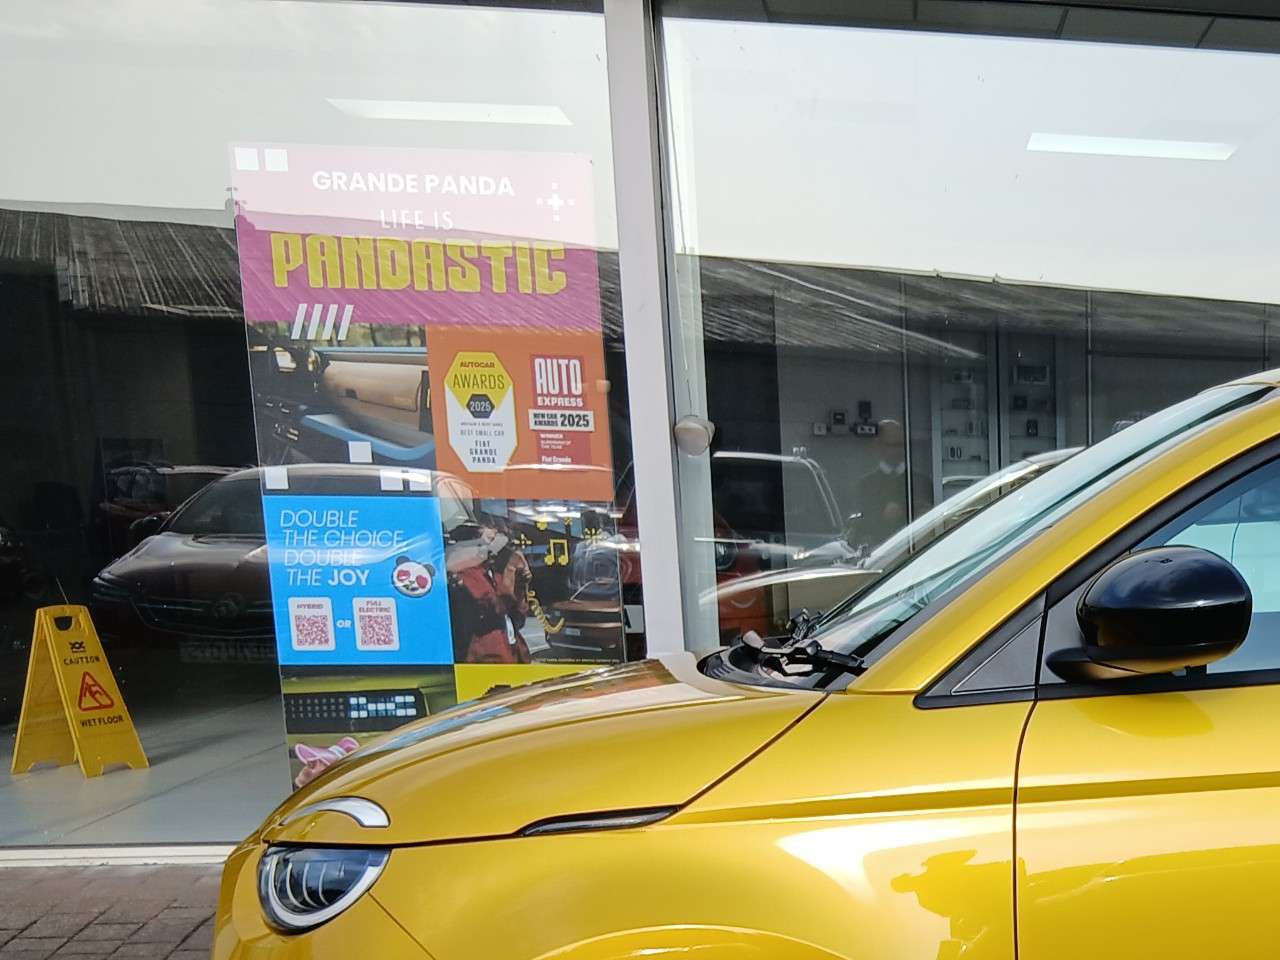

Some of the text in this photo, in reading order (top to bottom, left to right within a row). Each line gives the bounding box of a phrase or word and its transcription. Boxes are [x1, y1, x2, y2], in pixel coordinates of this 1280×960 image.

[312, 170, 515, 197] GRANDE PANDA
[379, 209, 454, 231] LIFE IS
[269, 231, 568, 296] PANDASTIC
[452, 373, 505, 390] AWARDS
[534, 357, 583, 395] AUTO
[470, 401, 492, 412] 2025
[537, 396, 584, 407] EXPRESS
[559, 413, 590, 428] 2025
[280, 510, 359, 528] DOUBLE
[282, 529, 318, 547] THE
[284, 549, 361, 567] DOUBLE
[287, 568, 370, 586] THE JOY
[336, 620, 352, 628] OR
[64, 656, 100, 665] CAUTION
[80, 715, 123, 727] WET FLOOR
